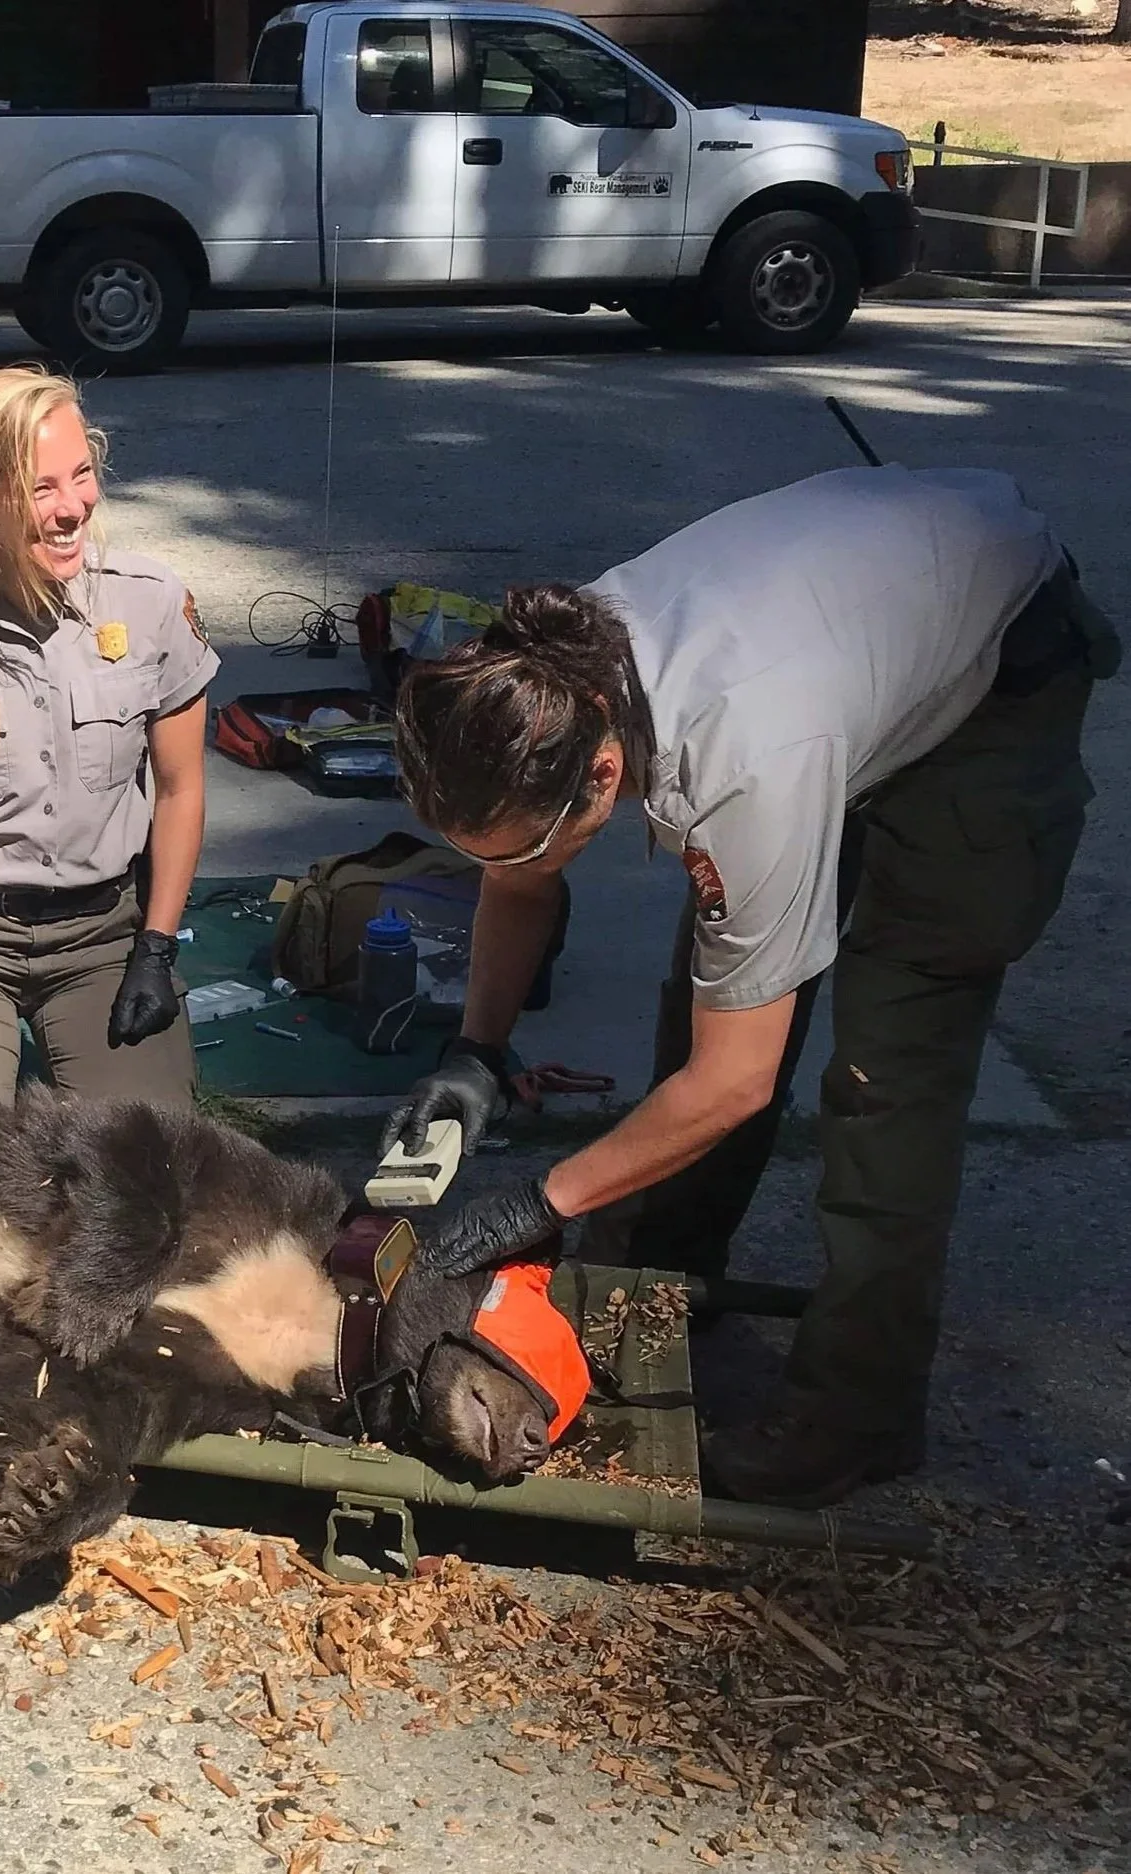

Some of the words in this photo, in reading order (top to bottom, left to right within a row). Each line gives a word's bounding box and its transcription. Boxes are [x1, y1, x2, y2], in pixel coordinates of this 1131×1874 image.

[573, 181, 588, 194] SEKI
[590, 181, 605, 194] Bear
[607, 181, 651, 197] Management
